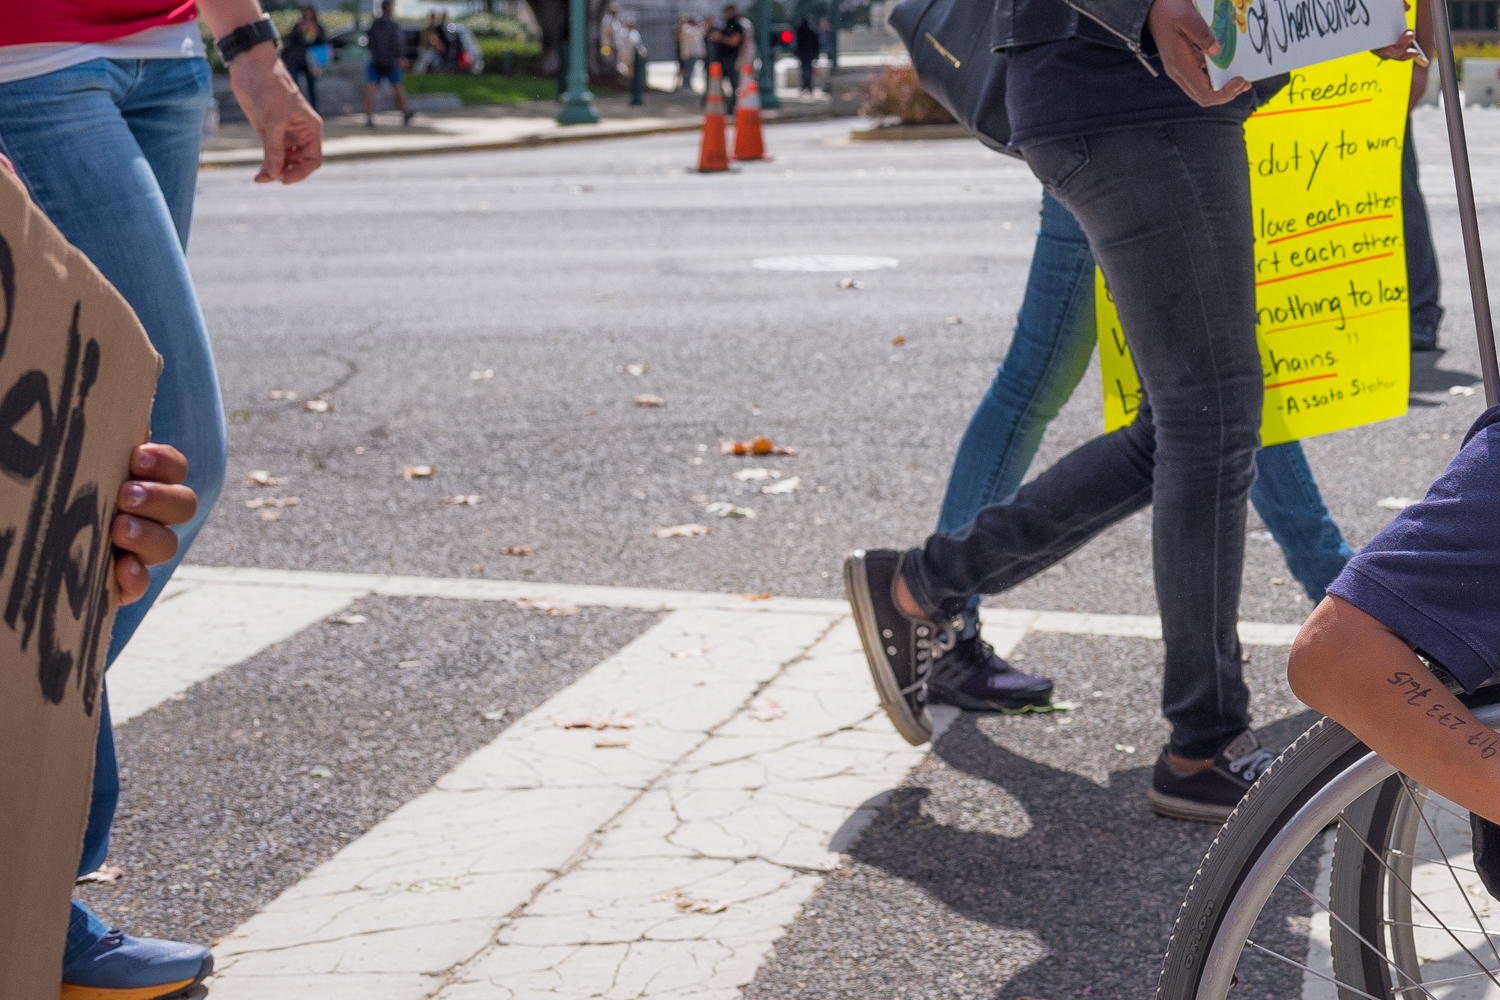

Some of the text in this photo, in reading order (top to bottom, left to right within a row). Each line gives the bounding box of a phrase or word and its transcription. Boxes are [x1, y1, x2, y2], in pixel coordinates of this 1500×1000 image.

[1287, 74, 1383, 104] freedom.
[1258, 141, 1328, 191] duty
[1336, 130, 1358, 160] to
[1261, 207, 1297, 238] love
[1307, 200, 1349, 228] each
[1290, 239, 1346, 268] each
[1257, 294, 1346, 331] nothing
[1347, 279, 1374, 308] to
[1426, 704, 1467, 730] 273
[1467, 731, 1498, 760] 917
[1184, 899, 1215, 970] orion
